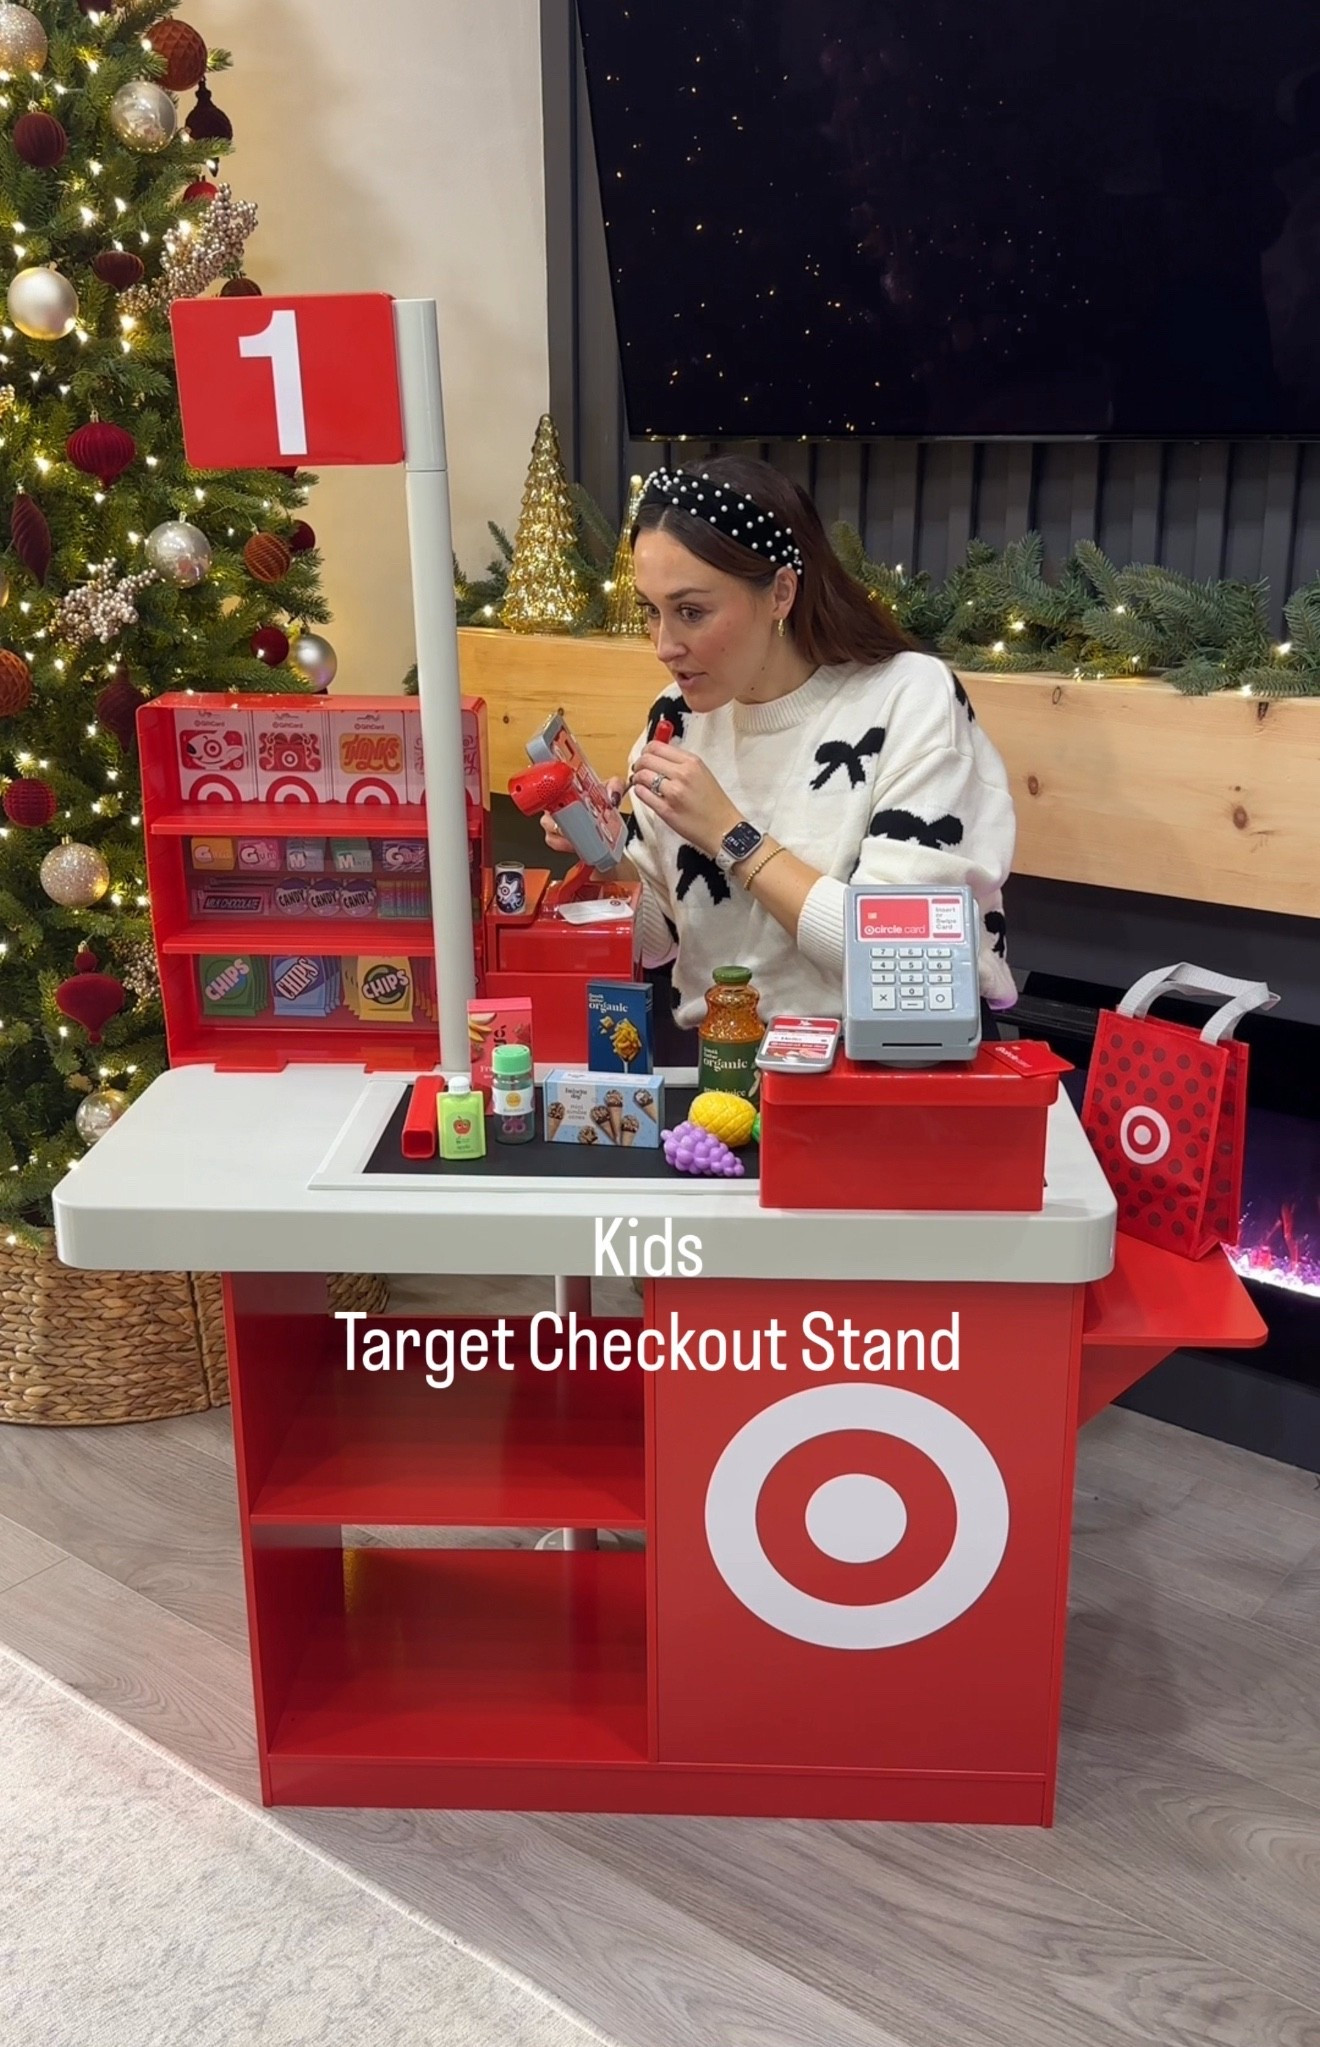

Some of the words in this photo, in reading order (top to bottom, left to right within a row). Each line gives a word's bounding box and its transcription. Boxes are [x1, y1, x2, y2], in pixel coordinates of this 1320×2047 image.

[238, 309, 307, 455] 1
[240, 845, 277, 865] Gum
[278, 889, 306, 907] CANDY
[310, 890, 337, 908] CANDY
[343, 891, 371, 909] CANDY
[874, 924, 902, 934] circle
[904, 924, 926, 934] card
[205, 958, 250, 1001] CHIPS
[275, 957, 320, 1000] CHIPS
[361, 968, 410, 1000] CHIPS
[588, 1002, 629, 1013] organic
[703, 1058, 748, 1072] organic
